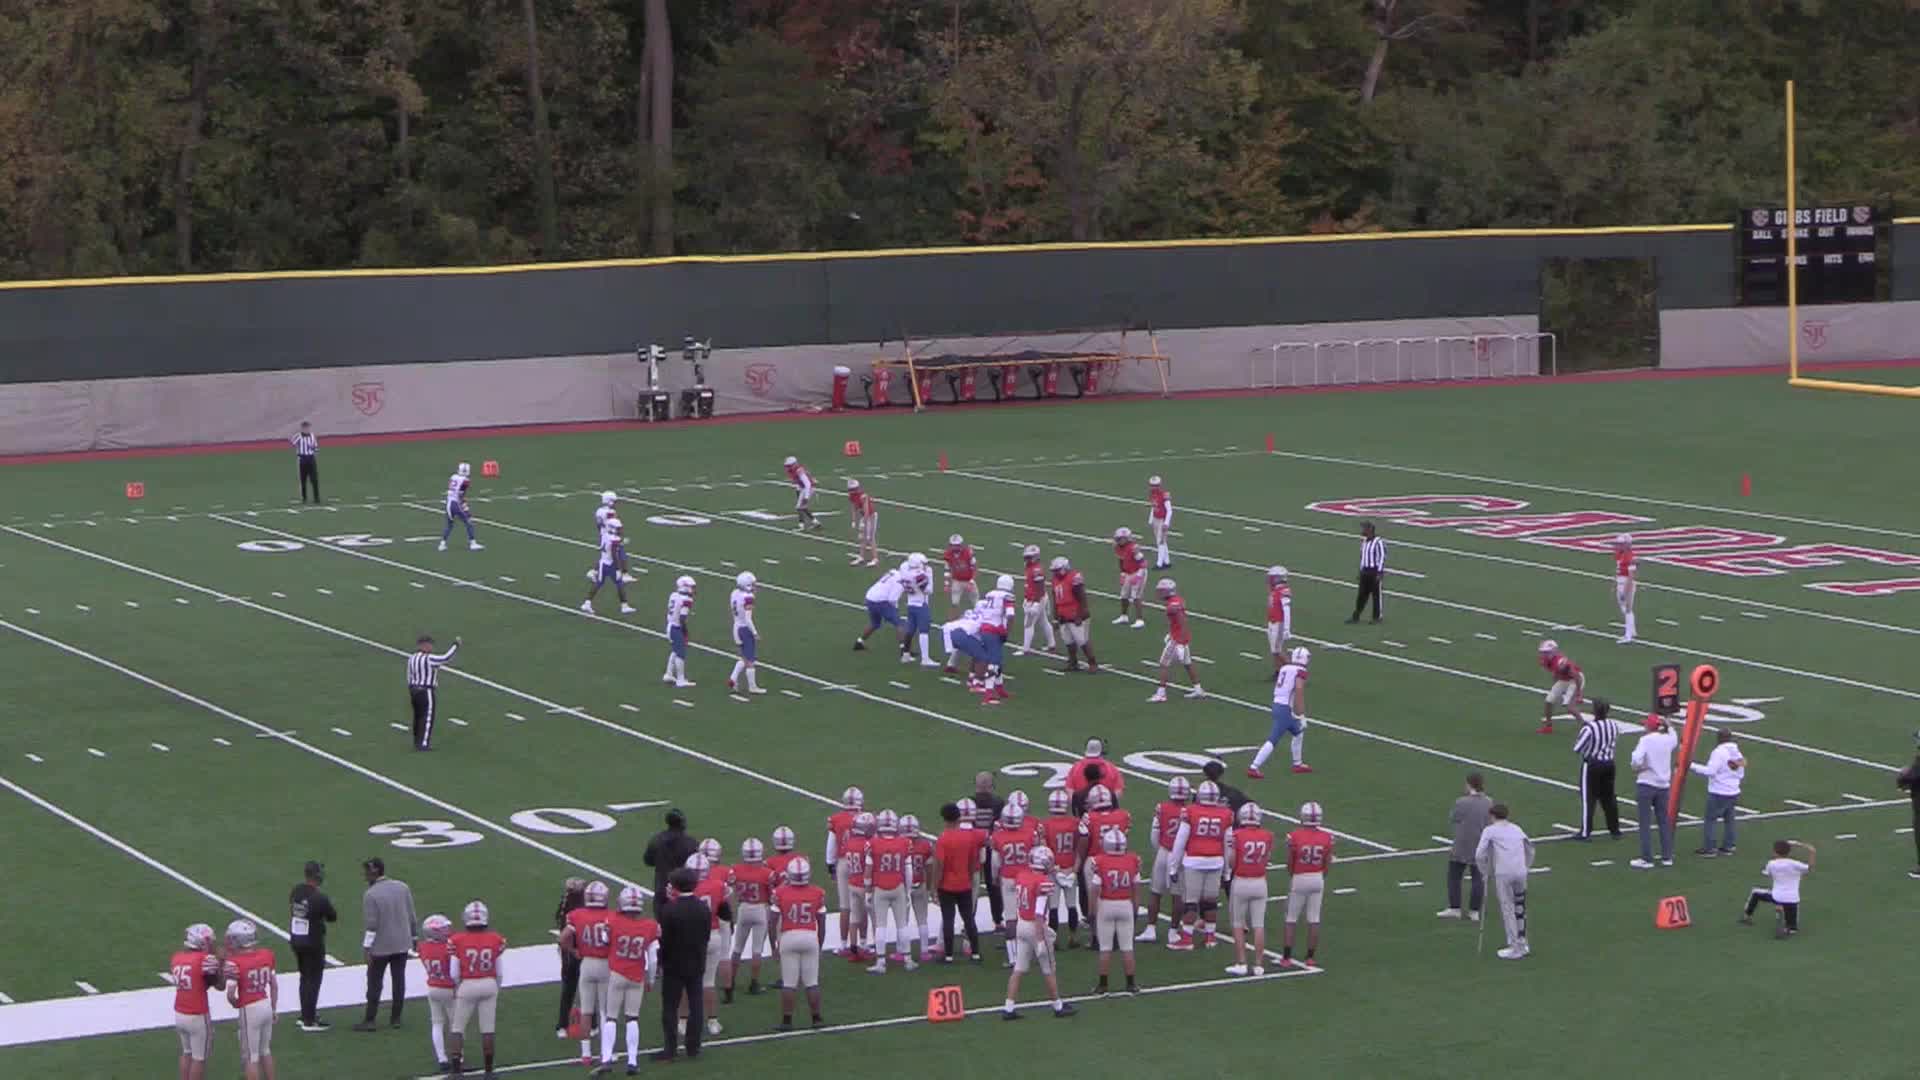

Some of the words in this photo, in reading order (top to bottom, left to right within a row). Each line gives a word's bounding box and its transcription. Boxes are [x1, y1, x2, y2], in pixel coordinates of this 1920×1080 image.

[1775, 210, 1811, 225] GIBS
[1815, 208, 1847, 223] FIELD
[1658, 668, 1678, 695] 2
[1197, 817, 1222, 837] 65
[880, 853, 900, 872] 81
[1003, 843, 1026, 865] 25
[1244, 841, 1266, 863] 27
[787, 903, 812, 924] 45
[1665, 900, 1687, 924] 20
[616, 935, 645, 959] 33
[465, 949, 493, 972] 78
[935, 990, 960, 1016] 30
